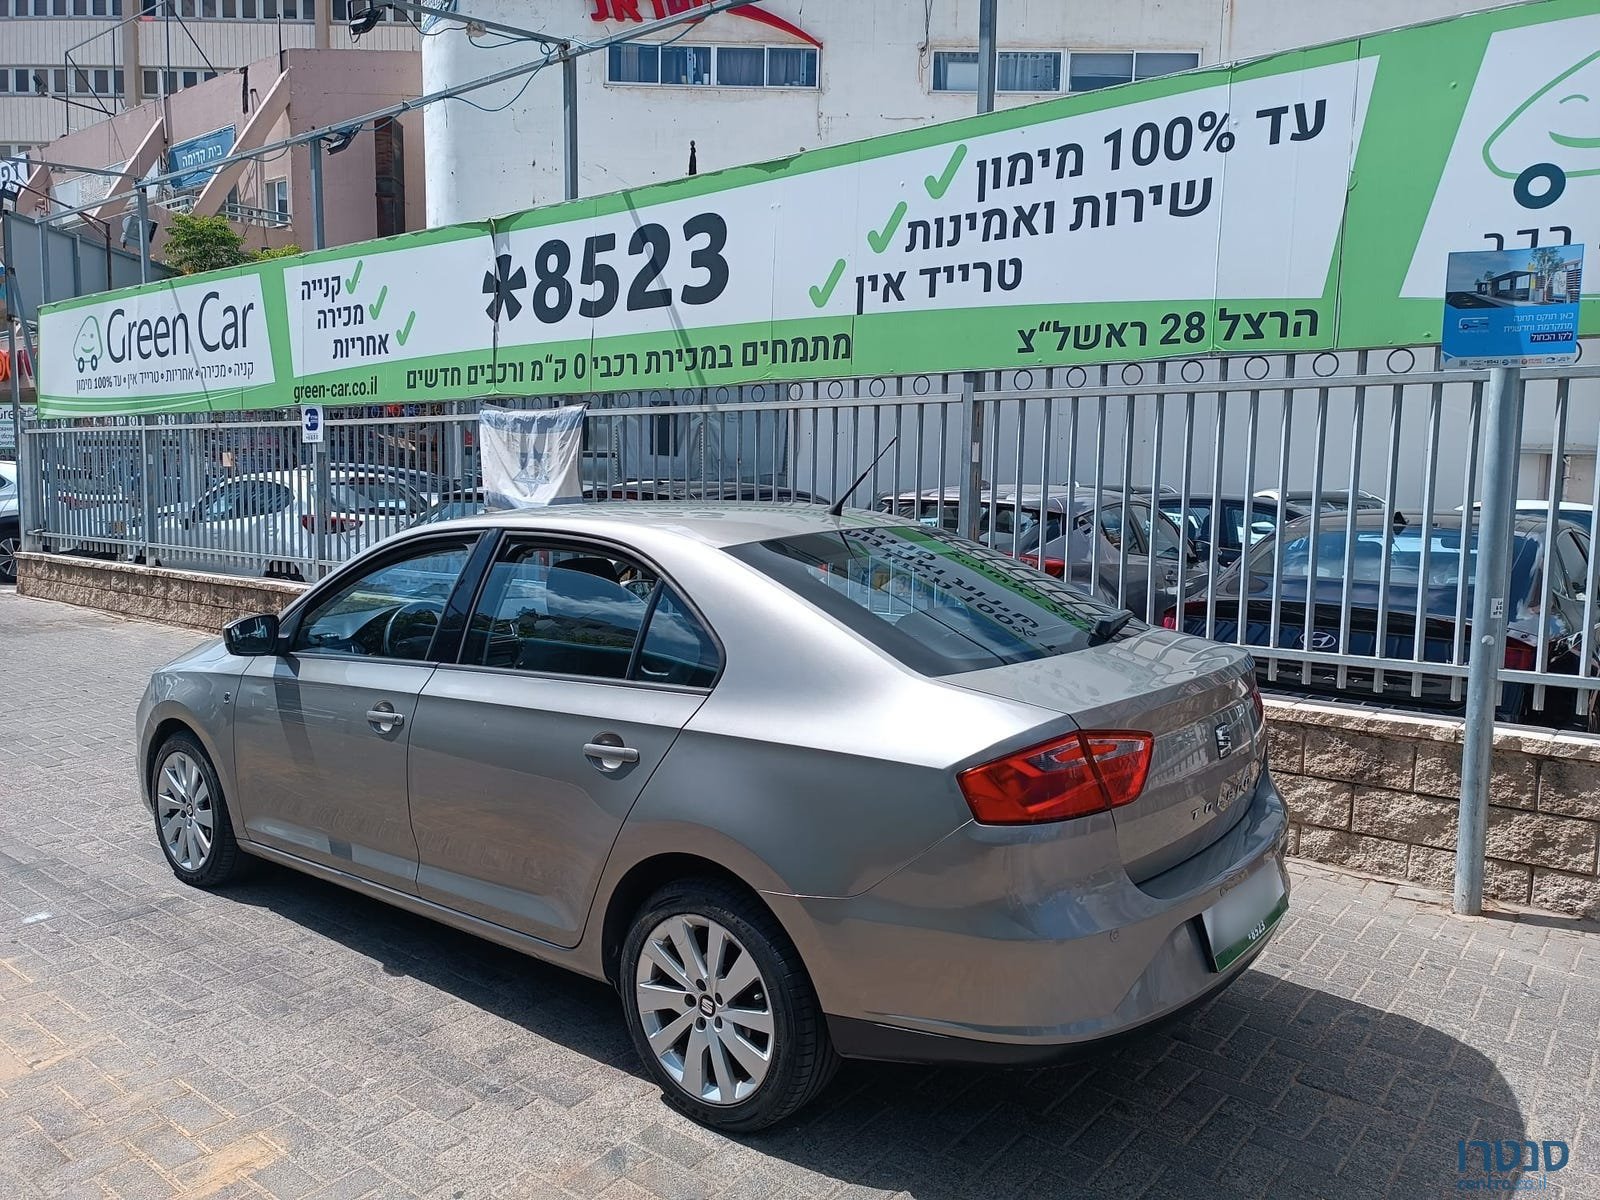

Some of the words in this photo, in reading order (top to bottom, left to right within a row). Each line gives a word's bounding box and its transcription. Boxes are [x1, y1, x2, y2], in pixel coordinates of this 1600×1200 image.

[1255, 98, 1327, 146] עד
[208, 145, 223, 159] בית
[1104, 110, 1236, 171] 100%
[976, 142, 1084, 203] מימון
[1069, 176, 1213, 232] שירות
[905, 200, 1055, 253] ואמינות
[301, 275, 341, 303] קנייה
[918, 257, 1023, 299] טרייד
[855, 270, 907, 316] אין
[107, 308, 190, 364] Green
[198, 291, 255, 353] Car
[317, 303, 364, 330] מכירה
[1159, 311, 1206, 346] 28
[1218, 307, 1319, 341] הרצל
[332, 333, 390, 360] אחריות
[645, 344, 733, 374] במכירת
[742, 333, 851, 367] מתמחים
[139, 370, 160, 384] טרייד
[165, 367, 193, 383] אחריות
[201, 364, 227, 379] מכירה
[234, 361, 254, 380] קניה
[406, 367, 461, 389] חדשים
[467, 362, 524, 386] ורכבים
[573, 353, 586, 379] 0
[592, 353, 638, 378] רכבי
[76, 378, 92, 394] מימון
[94, 376, 113, 389] 100%
[113, 375, 122, 387] עד
[127, 372, 137, 390] אין
[293, 375, 378, 403] green-car.co.il
